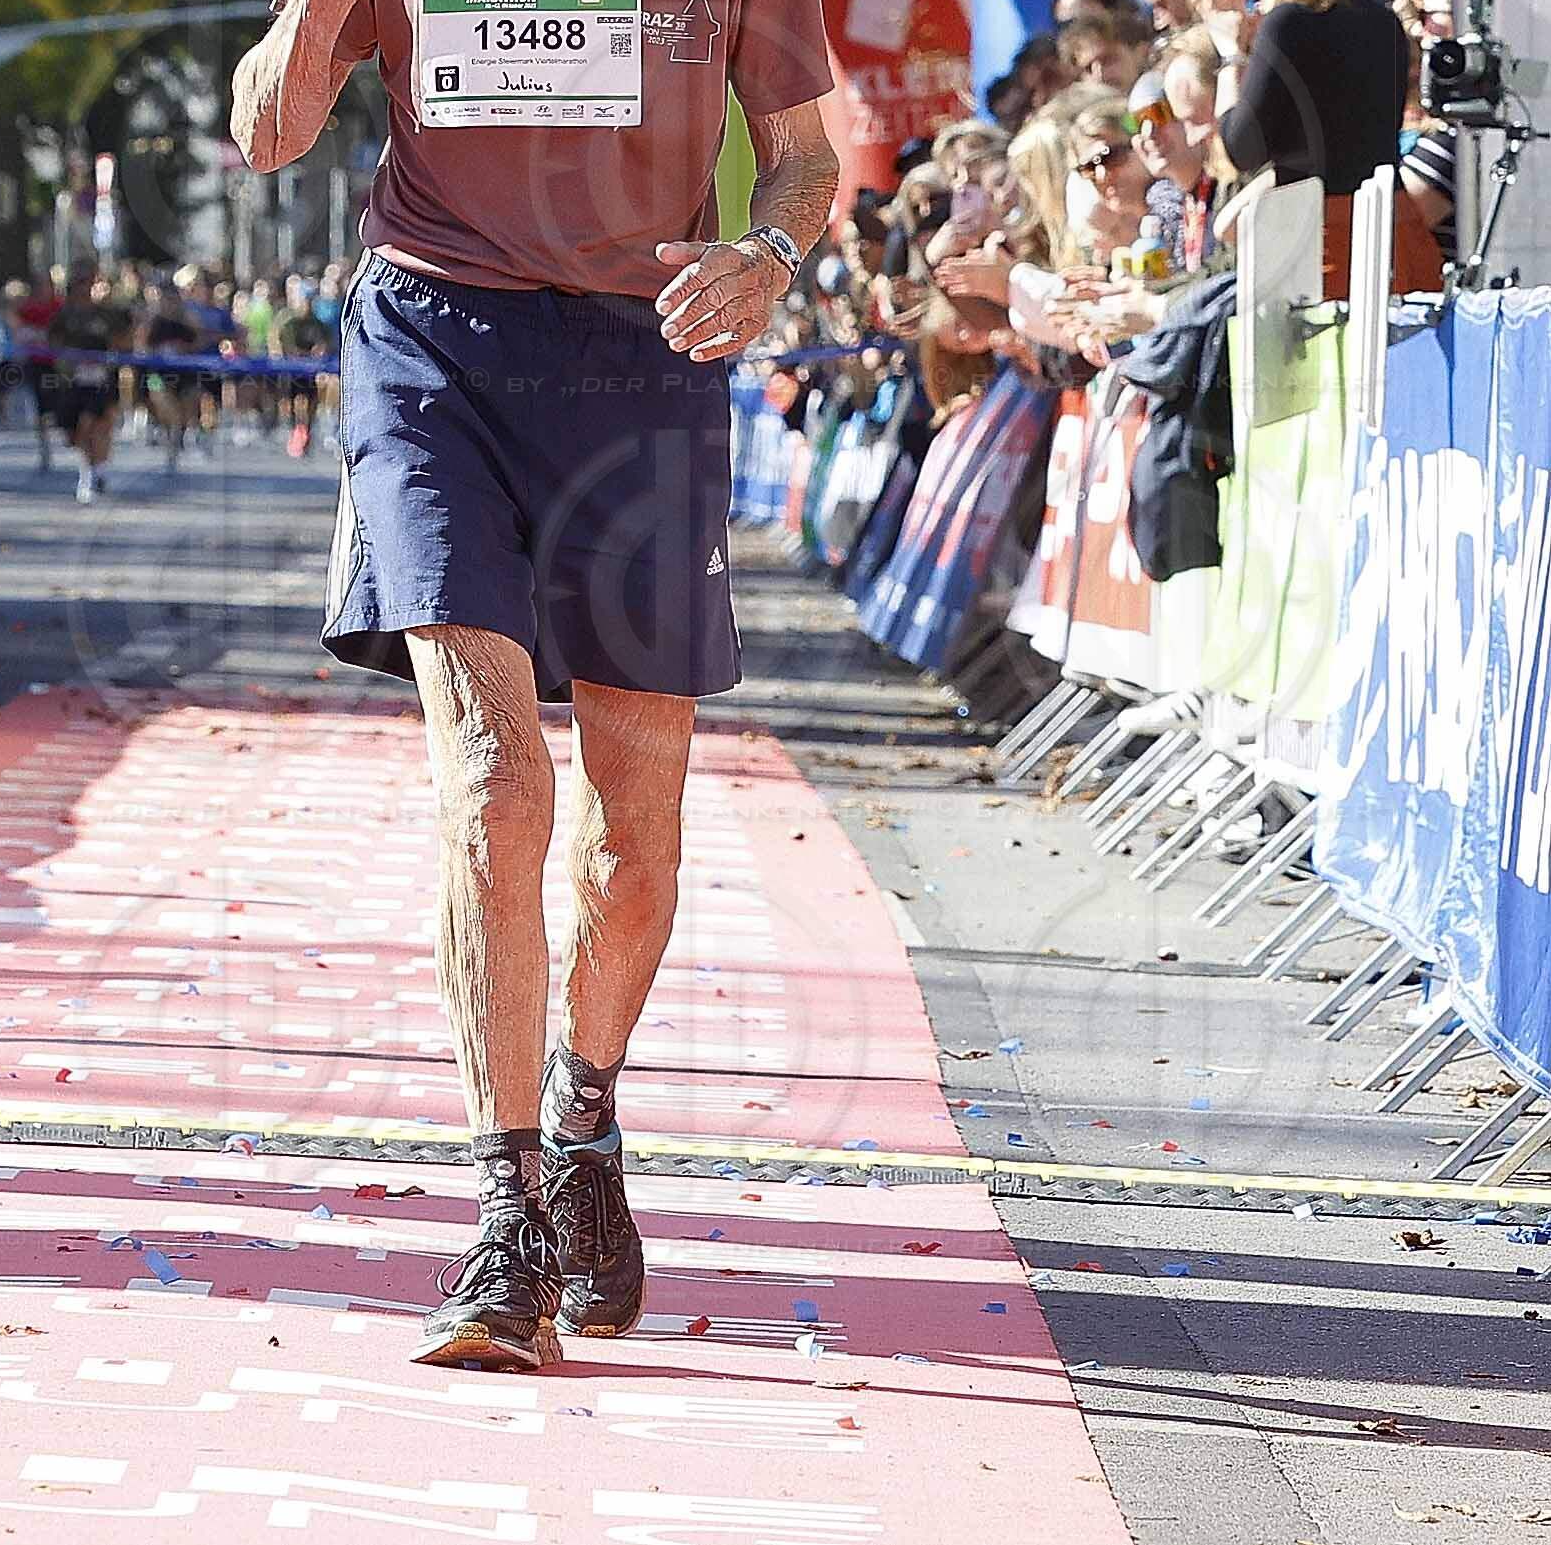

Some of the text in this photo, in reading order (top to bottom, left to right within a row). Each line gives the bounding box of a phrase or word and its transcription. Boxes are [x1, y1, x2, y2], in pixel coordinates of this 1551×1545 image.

[641, 11, 675, 28] RAZ
[474, 19, 586, 51] 13488
[442, 76, 453, 90] 0
[496, 71, 554, 93] Julius
